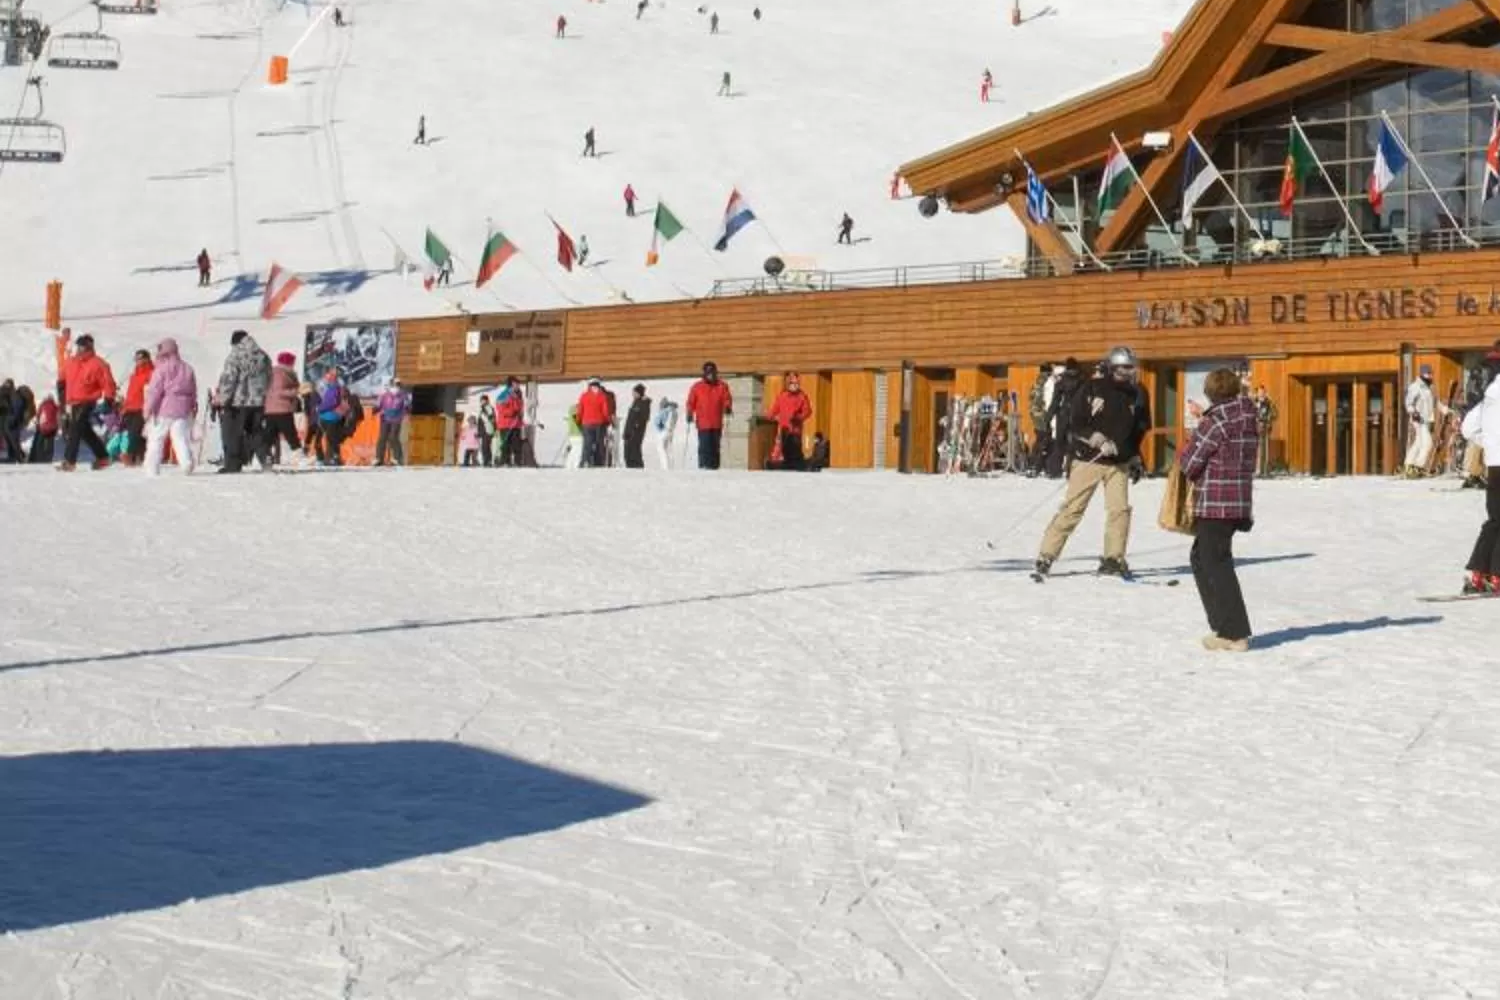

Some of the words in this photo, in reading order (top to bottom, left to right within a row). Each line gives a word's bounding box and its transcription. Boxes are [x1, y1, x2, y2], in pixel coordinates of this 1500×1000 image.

[1136, 296, 1251, 328] MAISON
[1271, 294, 1308, 323] DE
[1327, 287, 1440, 322] TIGNES
